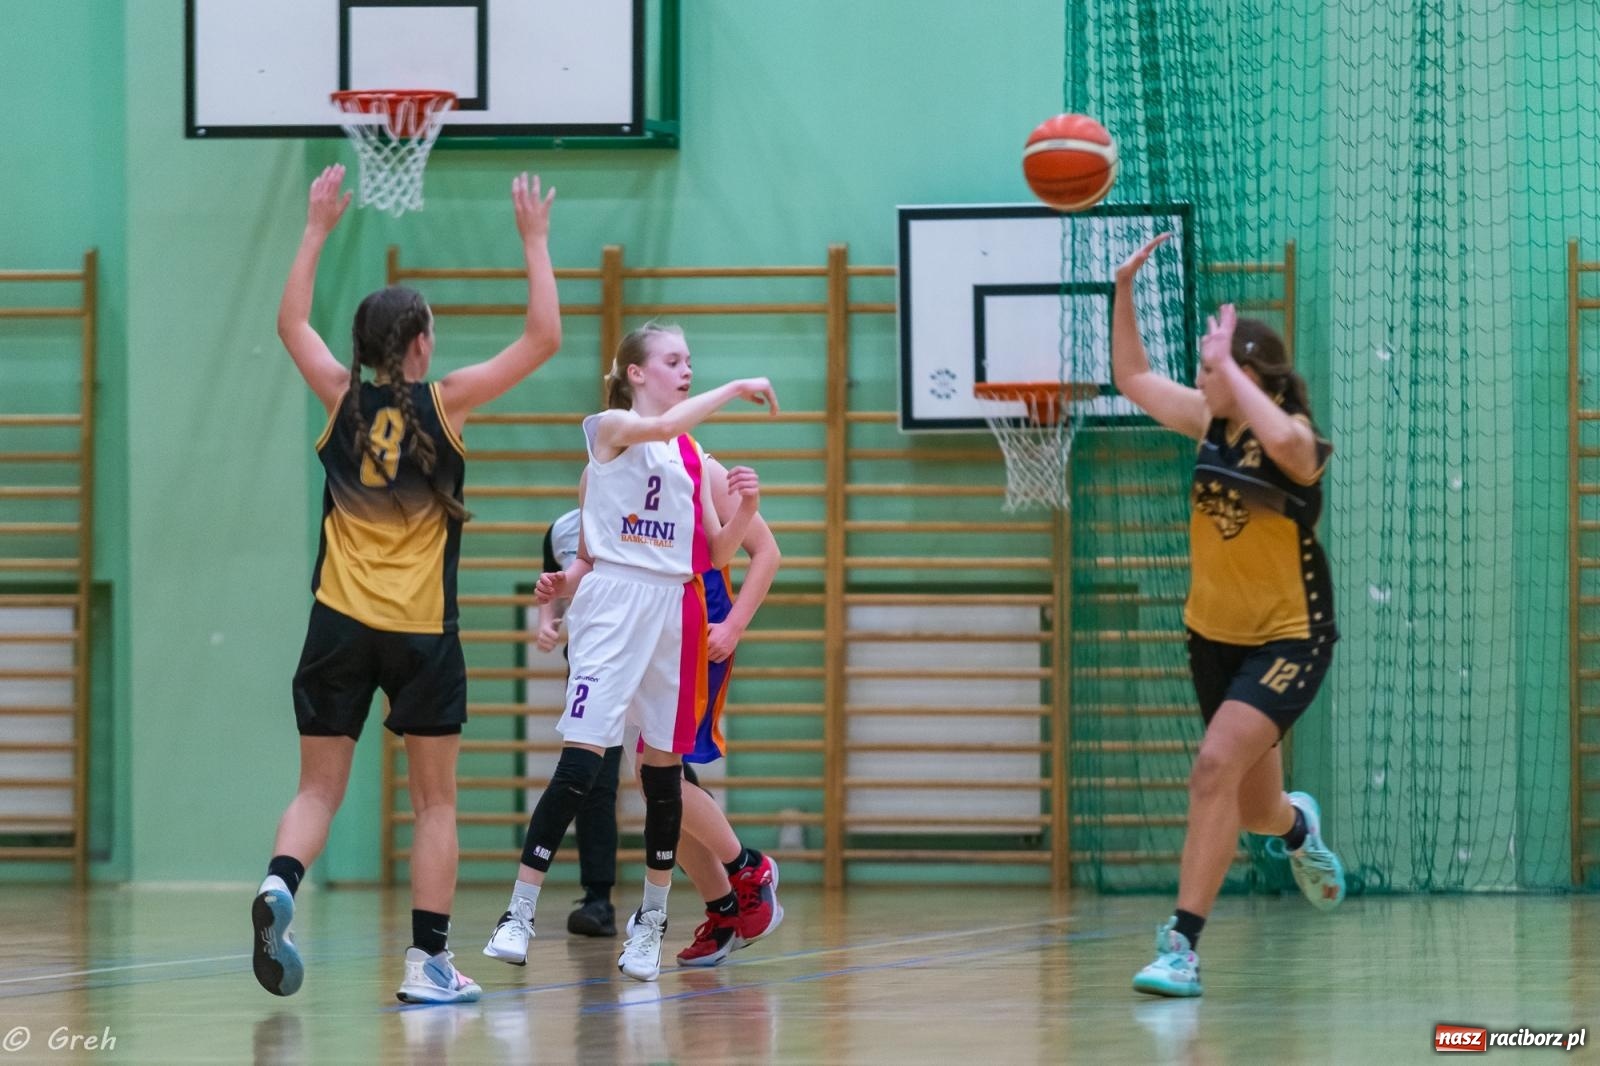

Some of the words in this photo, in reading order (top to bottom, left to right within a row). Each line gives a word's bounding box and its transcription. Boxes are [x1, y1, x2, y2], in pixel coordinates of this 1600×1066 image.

[644, 475, 661, 511] 2
[621, 516, 675, 540] MINI
[1259, 657, 1300, 694] 12
[570, 684, 589, 718] 2
